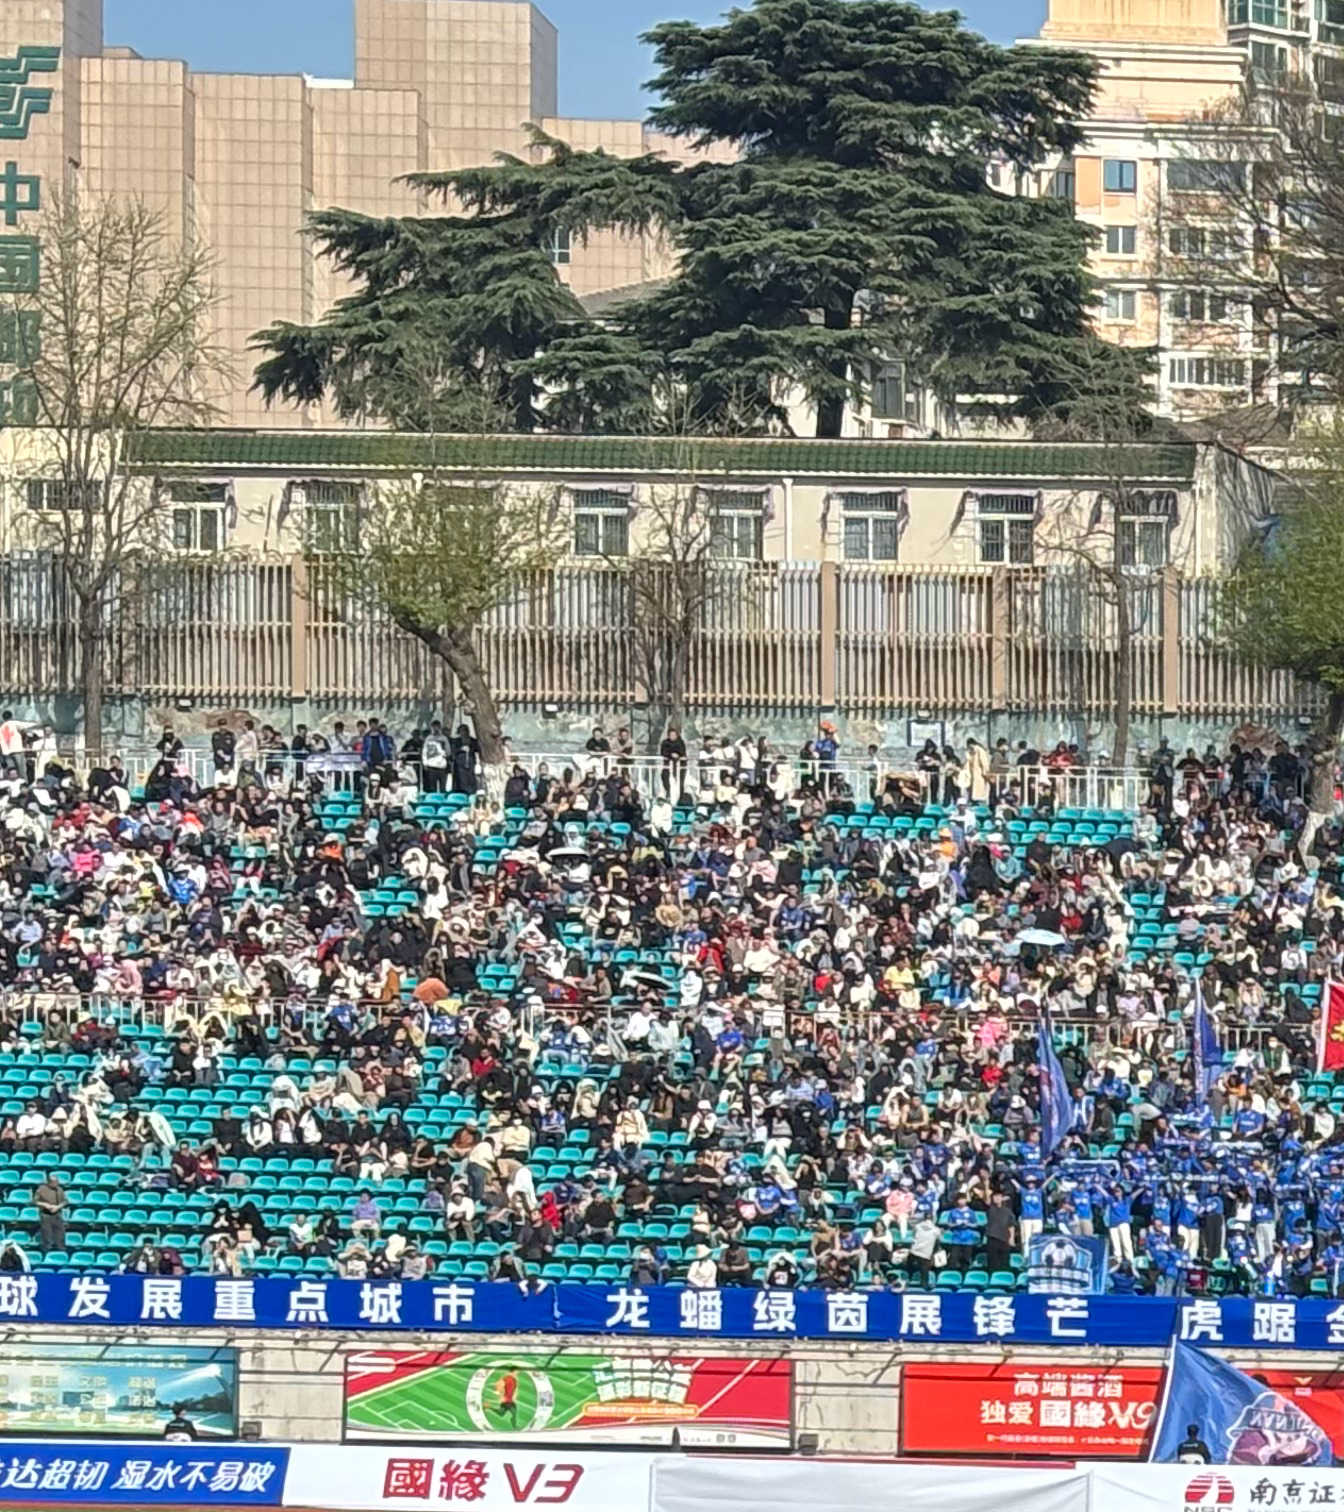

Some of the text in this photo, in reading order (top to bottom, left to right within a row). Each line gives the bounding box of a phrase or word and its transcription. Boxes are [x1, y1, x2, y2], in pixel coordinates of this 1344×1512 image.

[0, 1275, 476, 1326] 球发展重点城市
[606, 1286, 1089, 1338] 龙蟠绿茵展锋芒
[0, 1457, 110, 1491] 达超韧
